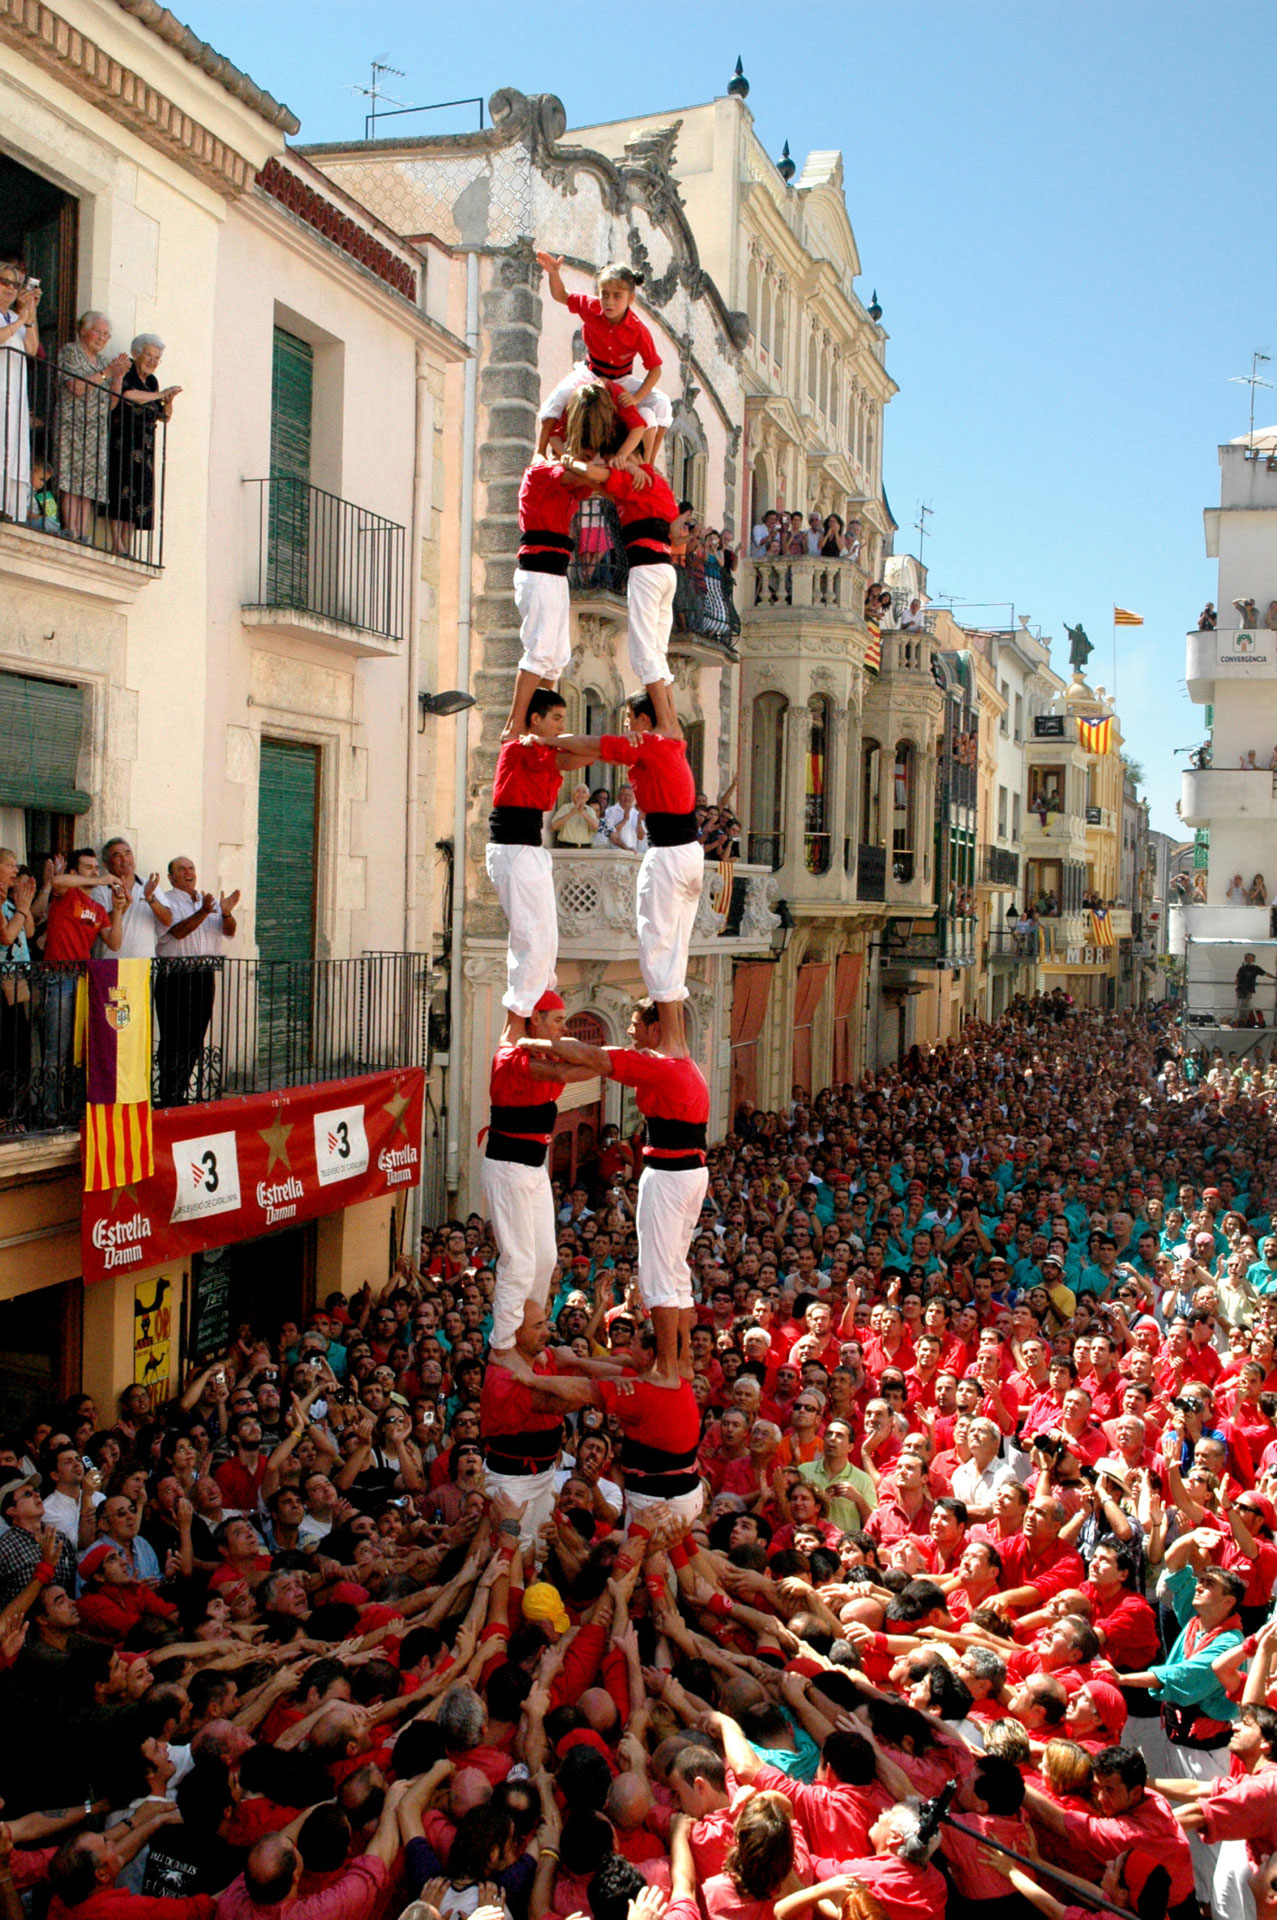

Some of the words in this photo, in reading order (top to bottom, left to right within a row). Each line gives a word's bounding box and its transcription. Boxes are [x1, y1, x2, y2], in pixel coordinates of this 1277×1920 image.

[337, 1121, 351, 1158] 3
[202, 1150, 219, 1193] 3
[377, 1144, 418, 1171] Estrella
[386, 1167, 412, 1186] Damm
[256, 1175, 305, 1209] Estrella
[265, 1203, 297, 1226] Damm
[92, 1213, 152, 1249] Estrella
[103, 1244, 144, 1270] Damm
